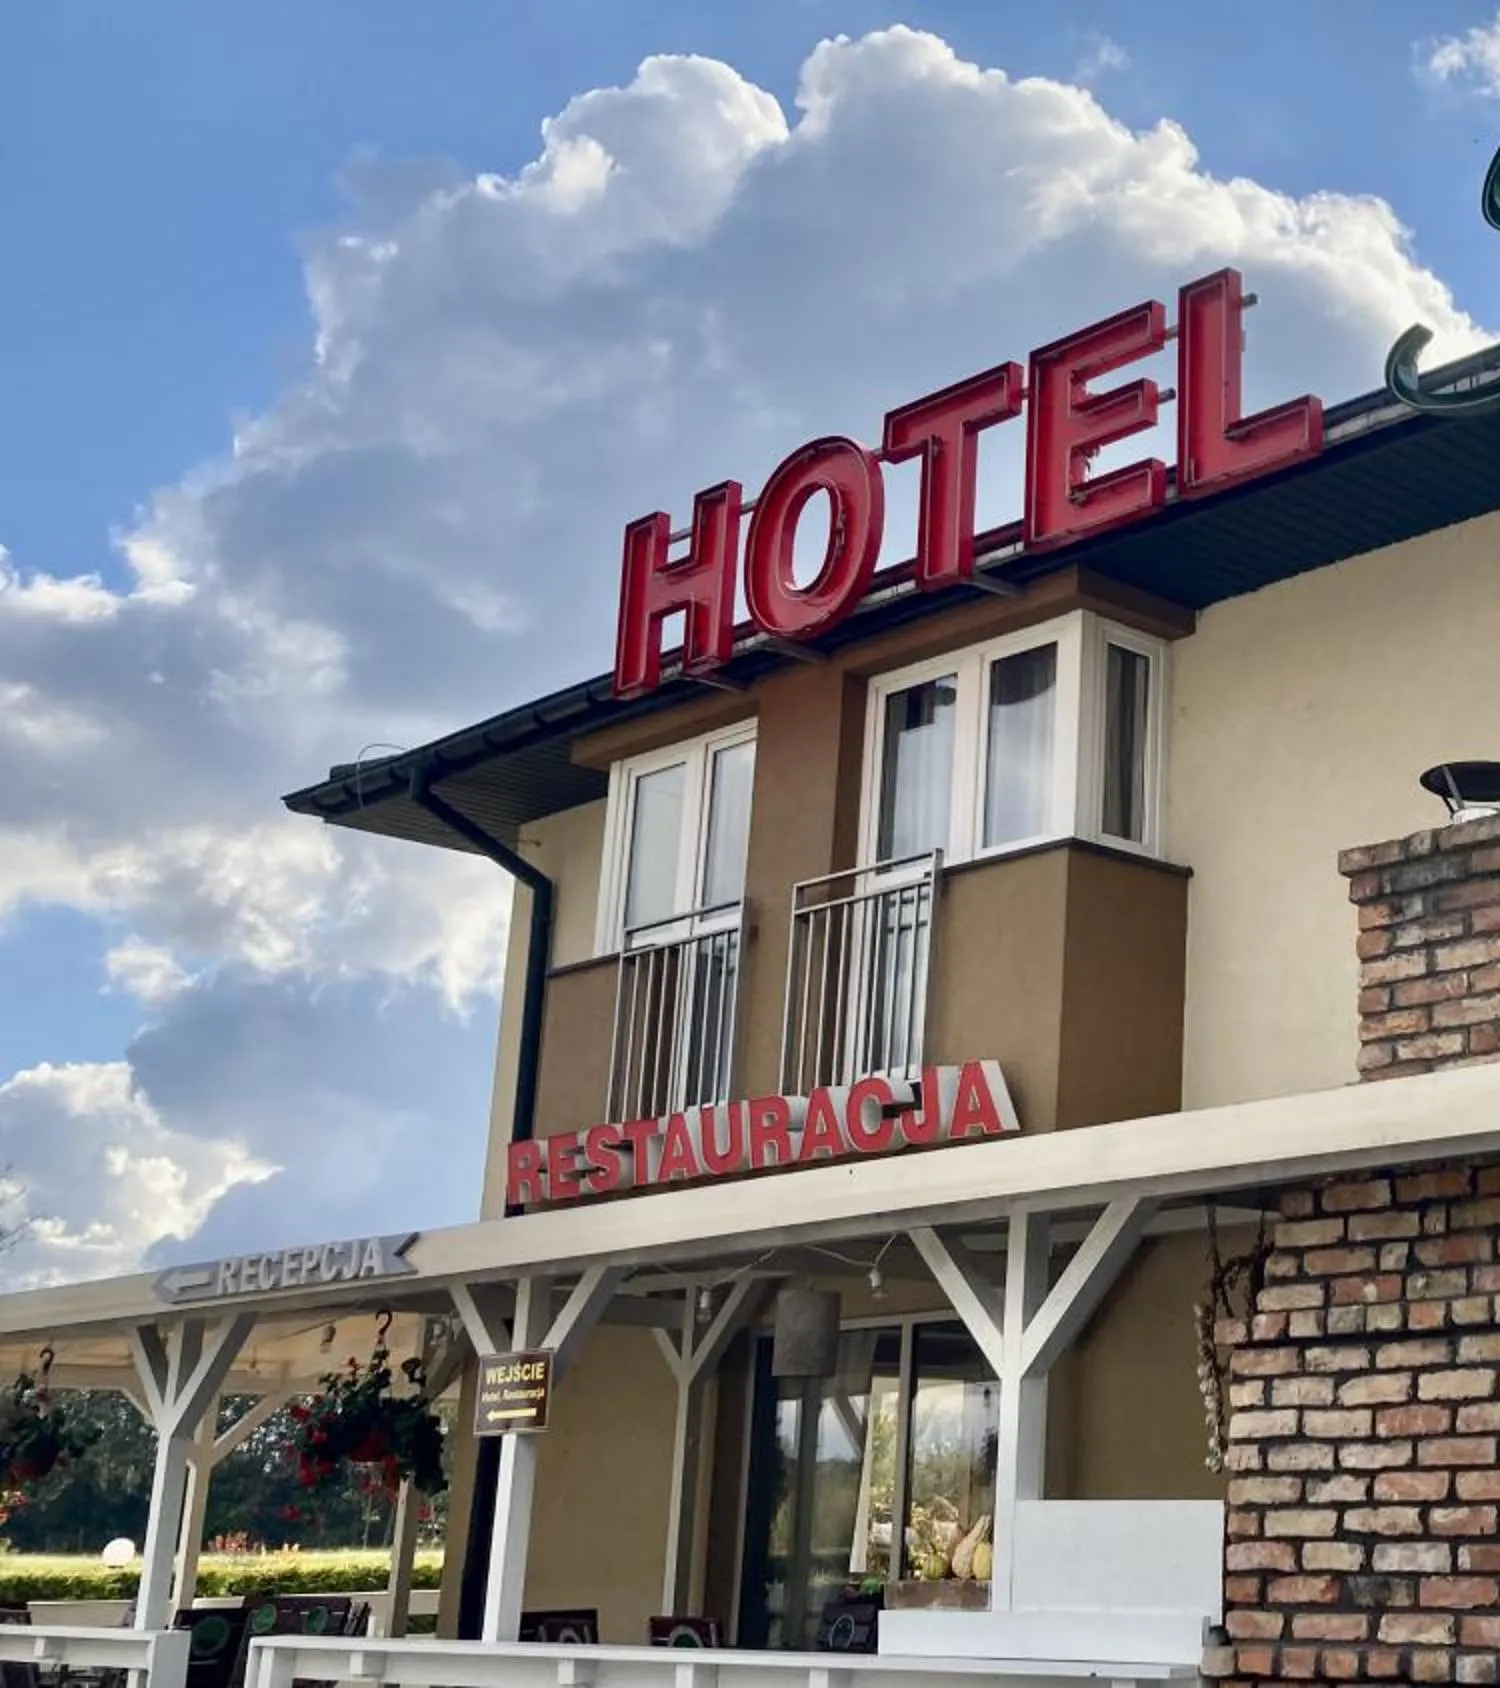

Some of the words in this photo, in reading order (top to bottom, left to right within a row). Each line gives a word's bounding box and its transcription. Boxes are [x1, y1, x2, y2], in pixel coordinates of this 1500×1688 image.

[612, 267, 1322, 699] HOTEL
[507, 1059, 1019, 1205] RESTAURACJA
[216, 1238, 385, 1294] RECEPCJA
[485, 1360, 545, 1385] WEJŚCIE
